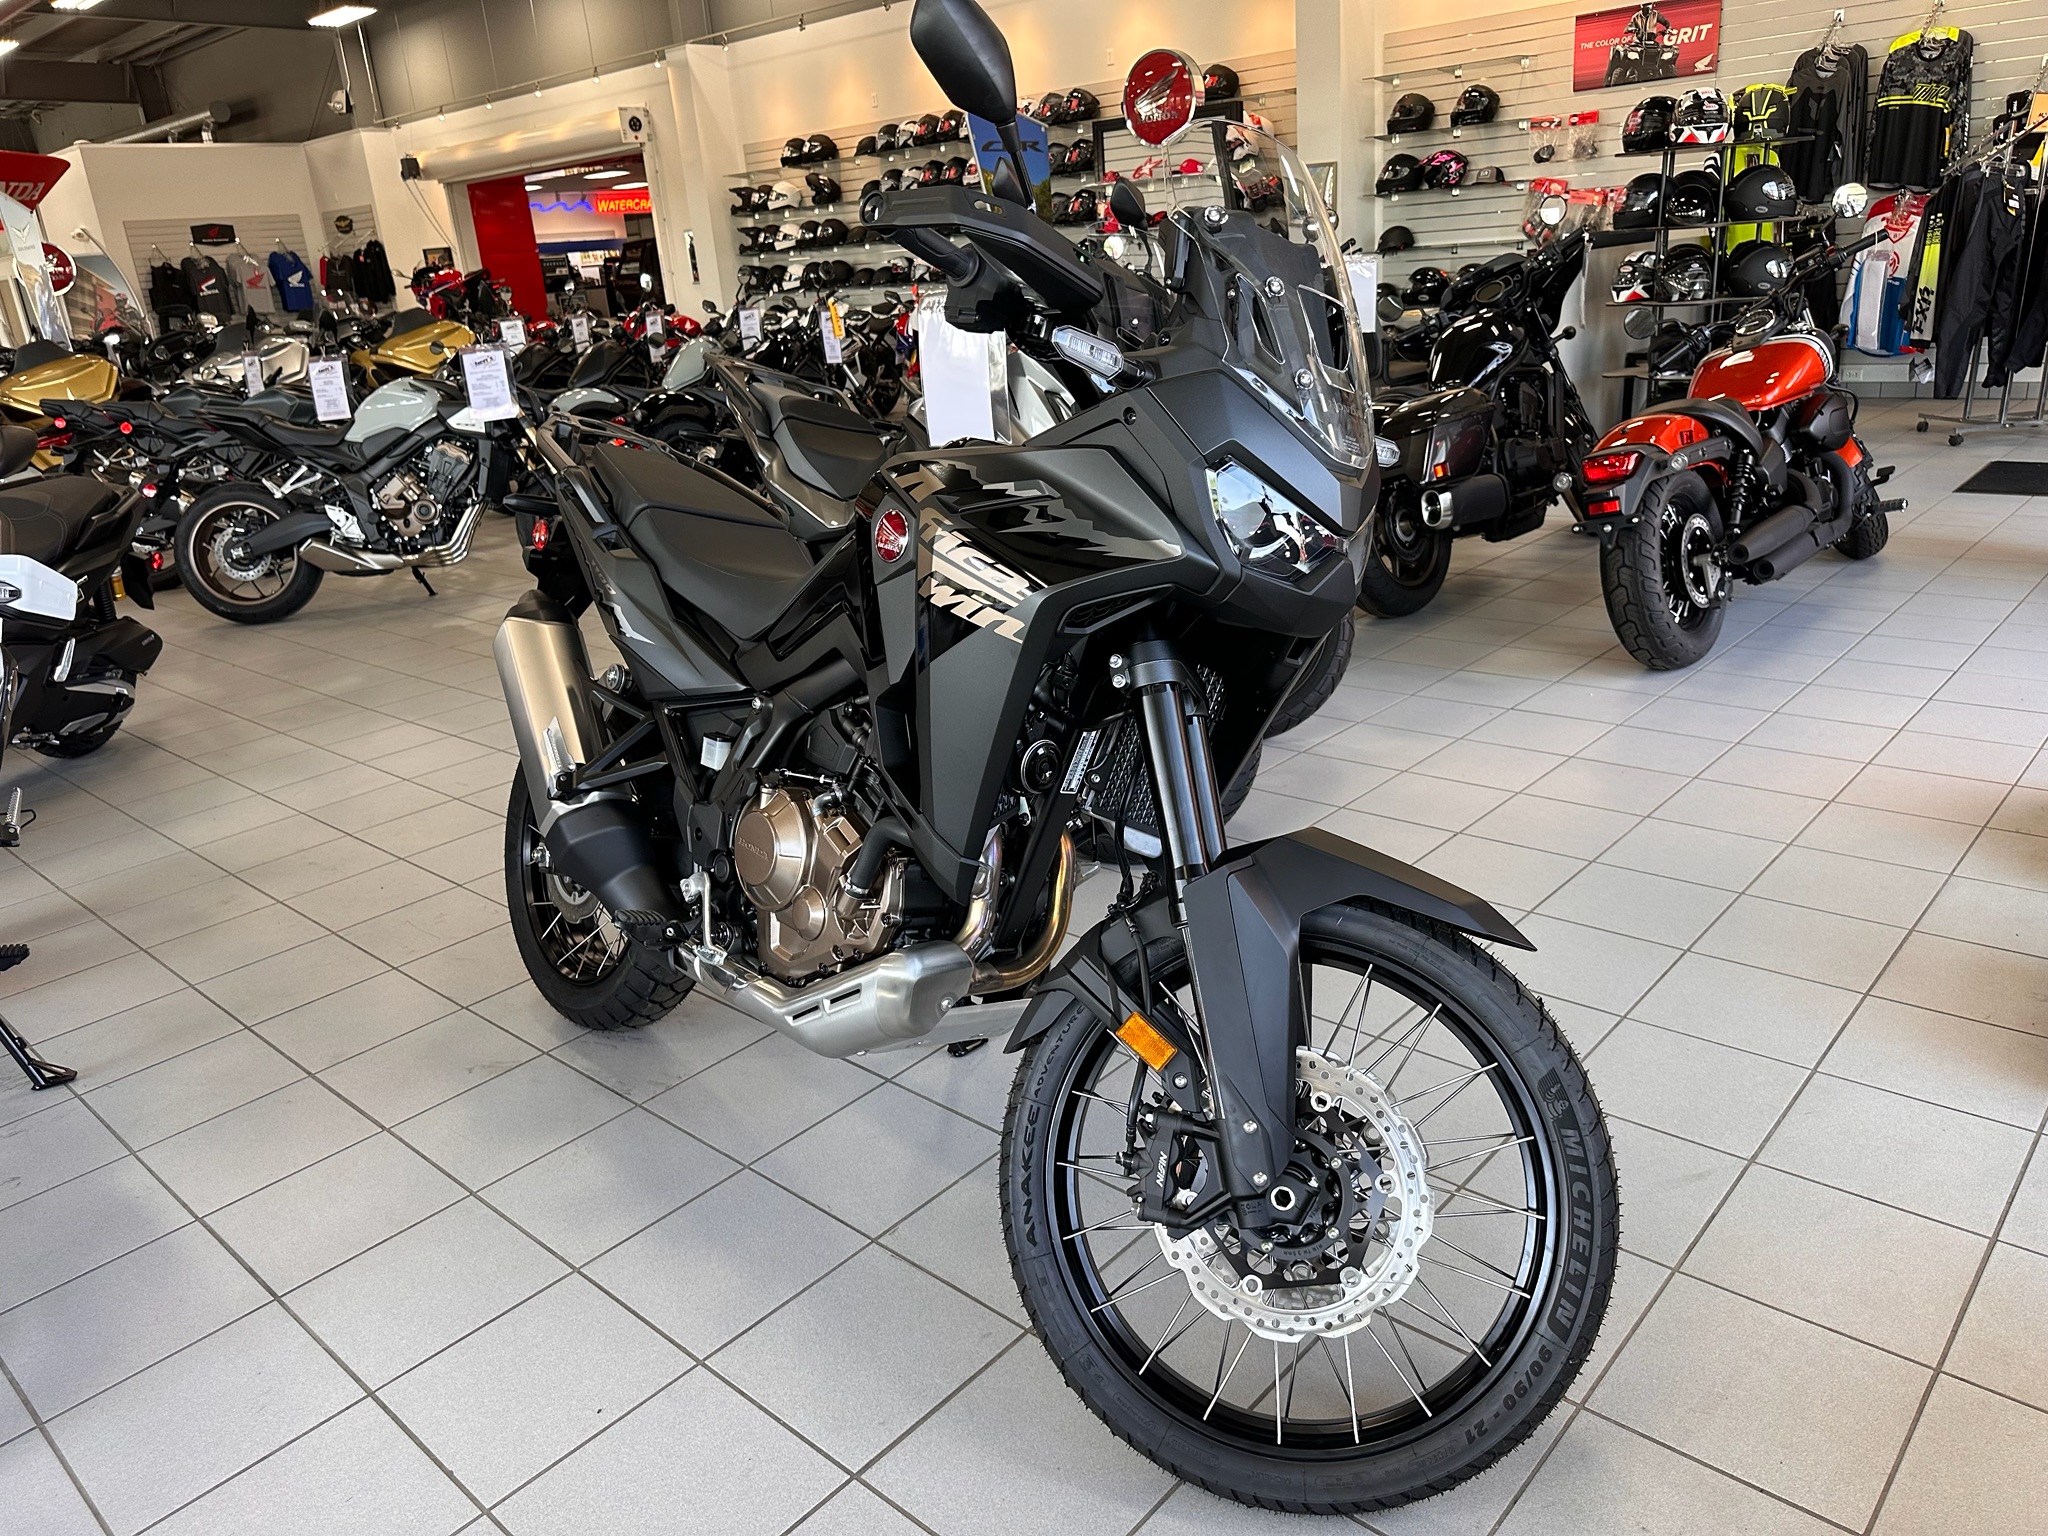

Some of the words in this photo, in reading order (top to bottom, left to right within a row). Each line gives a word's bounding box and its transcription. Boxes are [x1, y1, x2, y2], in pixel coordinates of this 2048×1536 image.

[1595, 38, 1620, 48] COLOR
[1663, 23, 1713, 46] GRIT
[1137, 111, 1179, 124] HONDA
[981, 140, 1044, 153] CR
[1021, 1103, 1041, 1247] ANAKEE
[1034, 1004, 1085, 1099] ADVENTURE
[1555, 1127, 1594, 1329] MICHELIN
[1503, 1345, 1553, 1411] 90/90
[1464, 1418, 1489, 1446] 21
